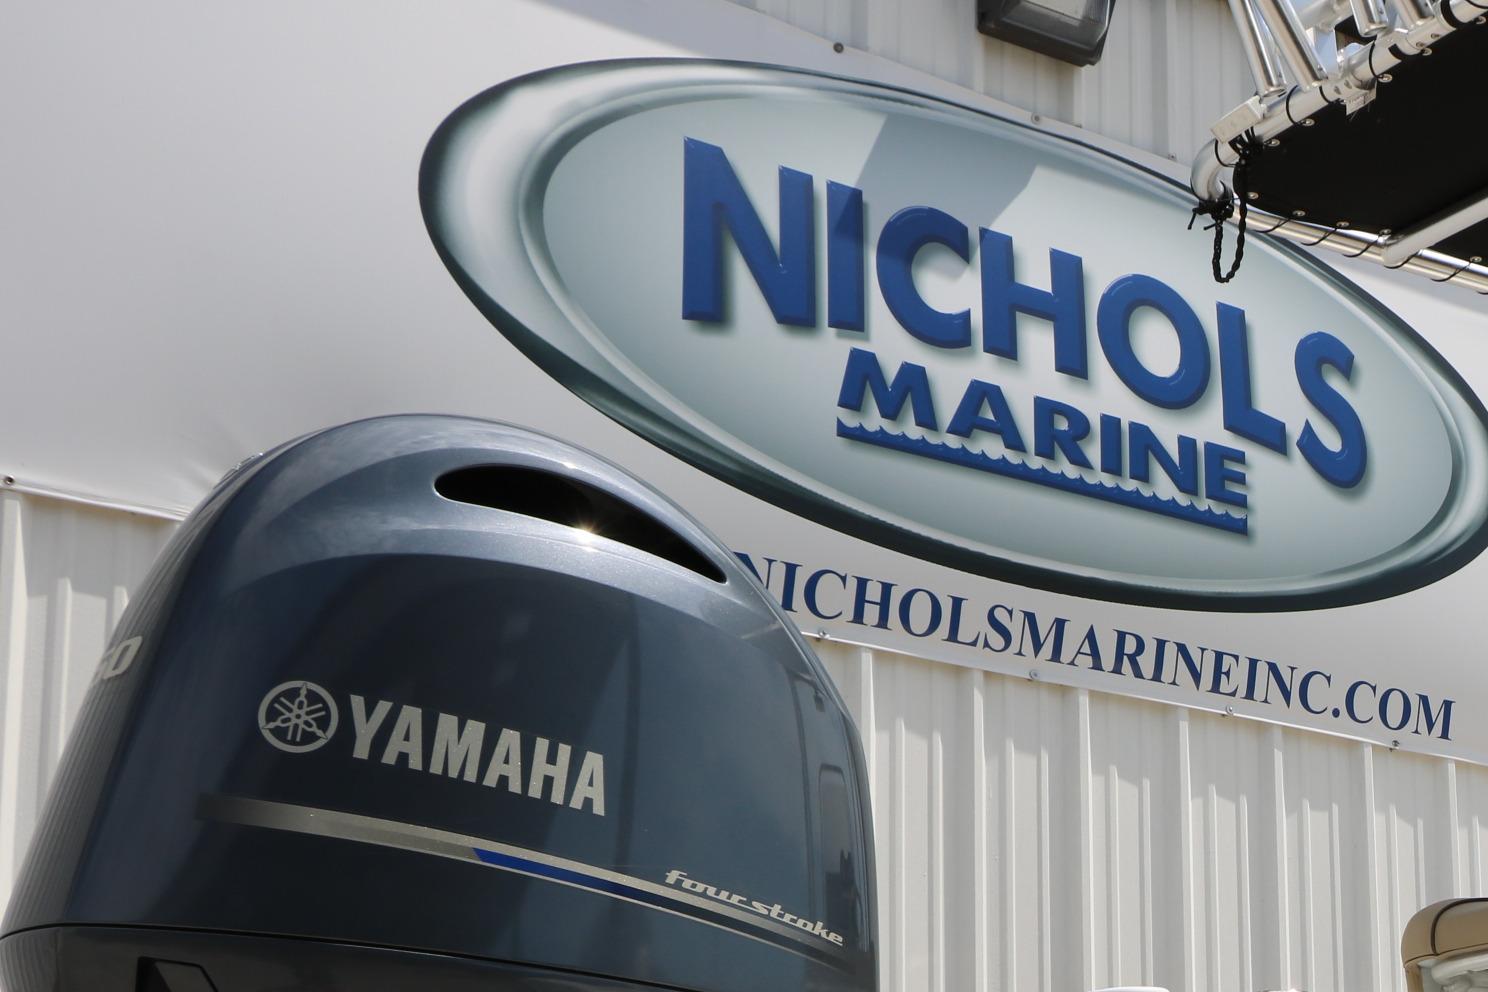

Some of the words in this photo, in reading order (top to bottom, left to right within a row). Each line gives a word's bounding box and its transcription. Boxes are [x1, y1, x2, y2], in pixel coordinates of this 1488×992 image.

[683, 136, 1368, 490] NICHOLS
[837, 347, 1249, 509] MARINE
[733, 551, 1457, 743] NICHOLSMARINEINC.COM
[349, 695, 606, 816] YAMAHA
